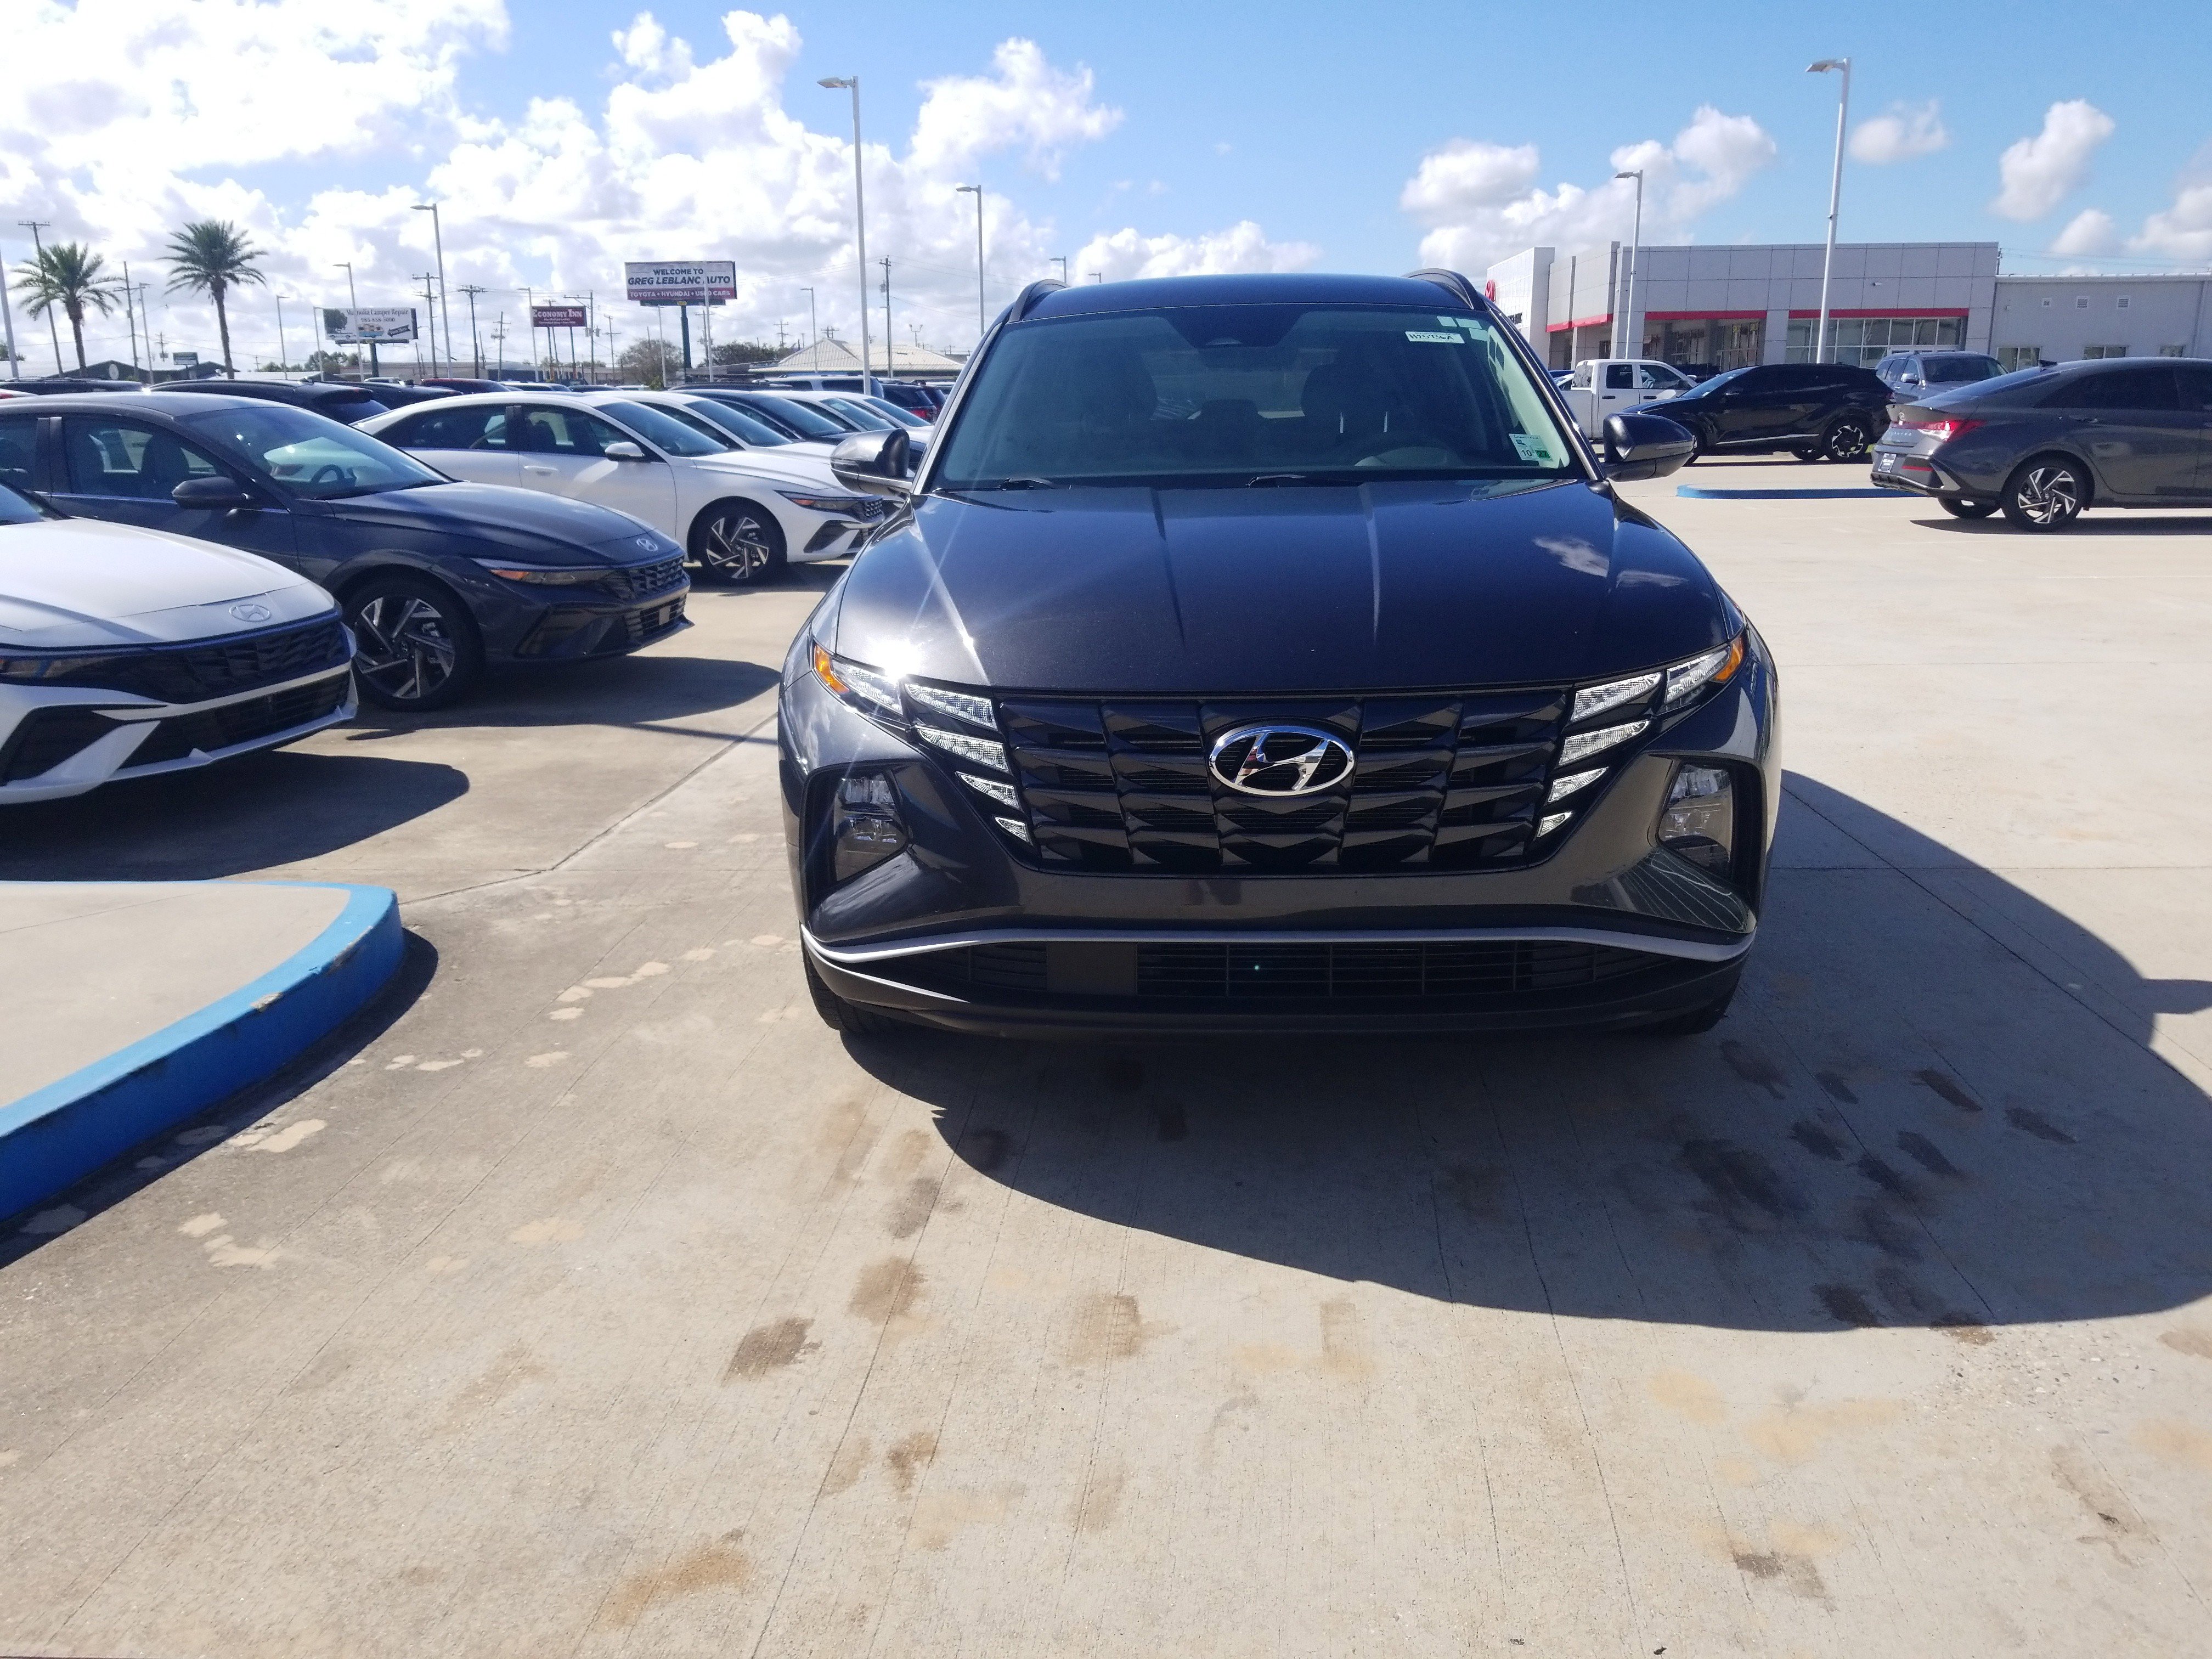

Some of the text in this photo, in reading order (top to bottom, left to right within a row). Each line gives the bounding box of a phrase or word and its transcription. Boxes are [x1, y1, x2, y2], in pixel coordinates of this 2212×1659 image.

[656, 276, 701, 285] LEBLANC
[370, 309, 390, 317] Camper
[392, 308, 409, 317] Repair
